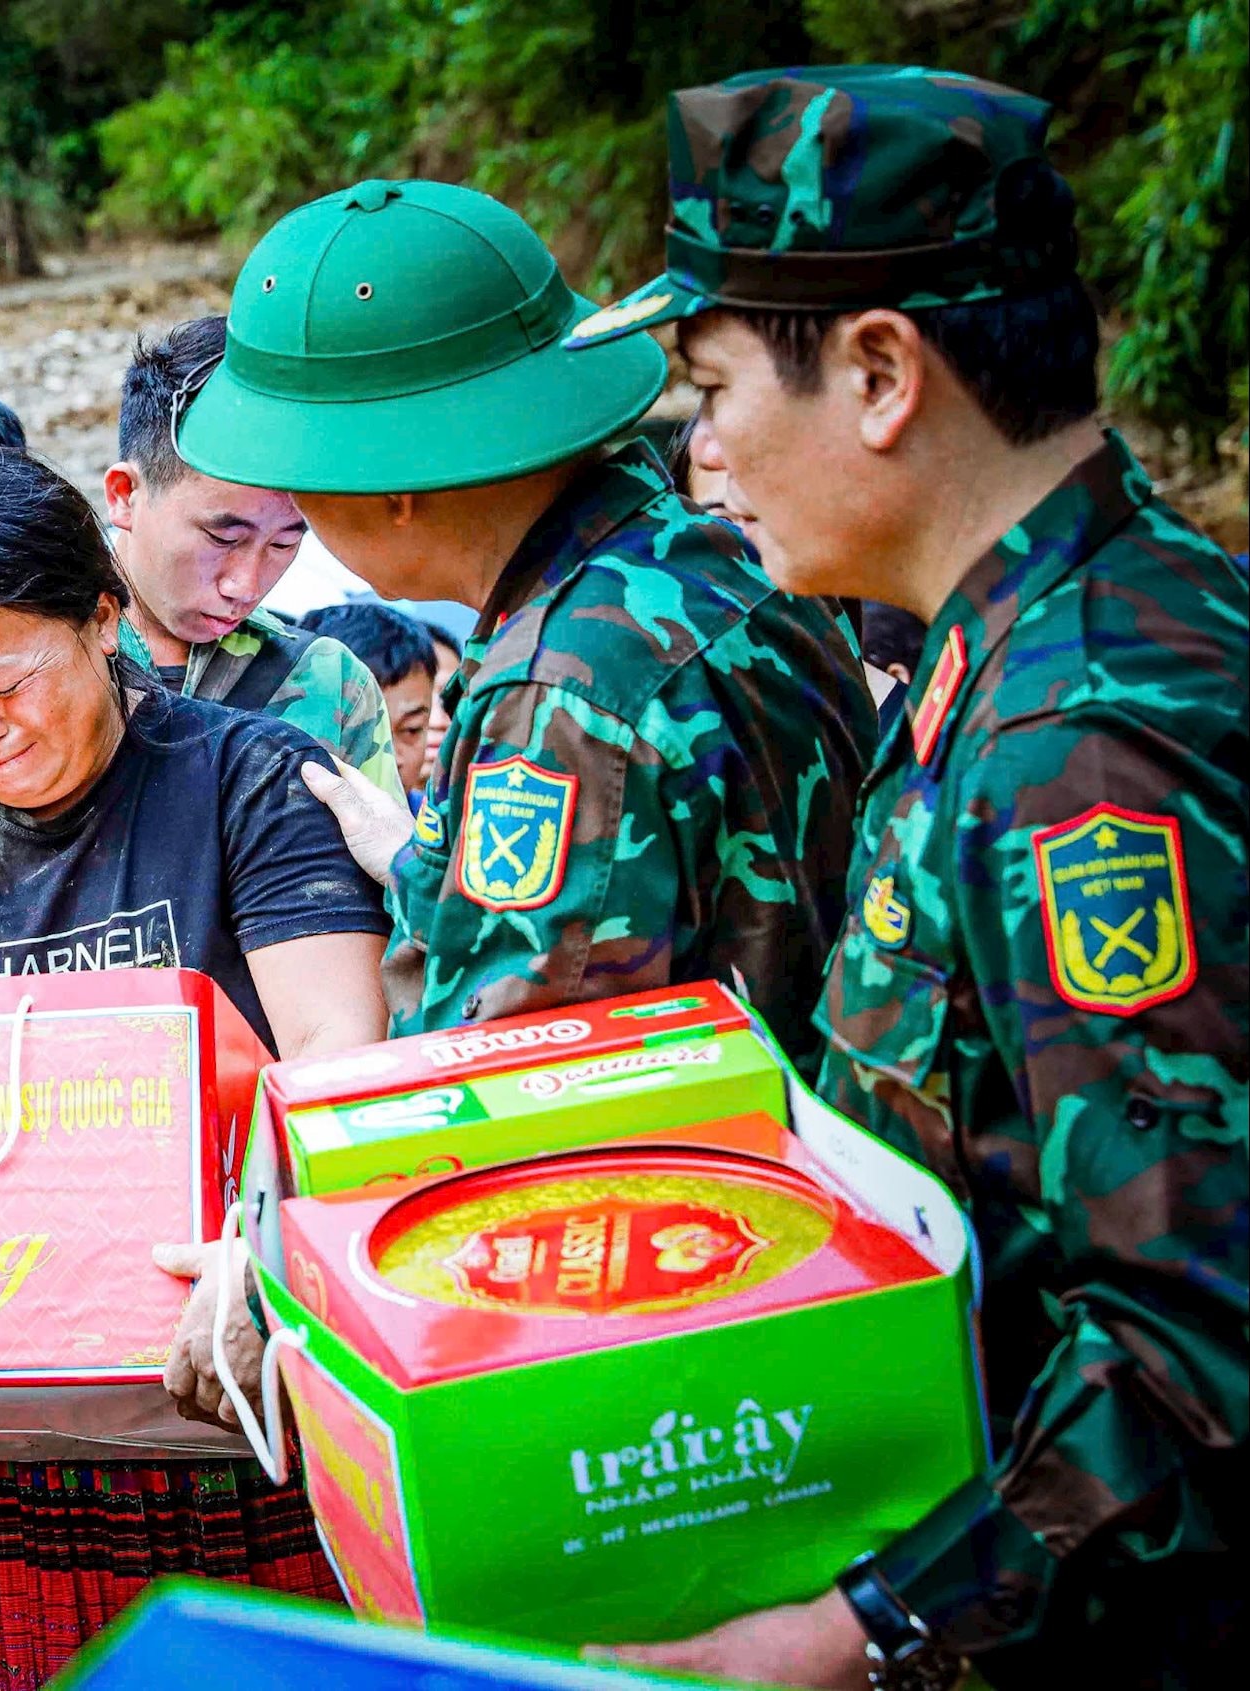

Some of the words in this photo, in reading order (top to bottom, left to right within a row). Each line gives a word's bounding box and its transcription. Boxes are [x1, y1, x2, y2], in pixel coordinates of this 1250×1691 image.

[20, 1076, 56, 1143] SỰ
[59, 1061, 124, 1137] QUỐC
[131, 1076, 172, 1128] GIA
